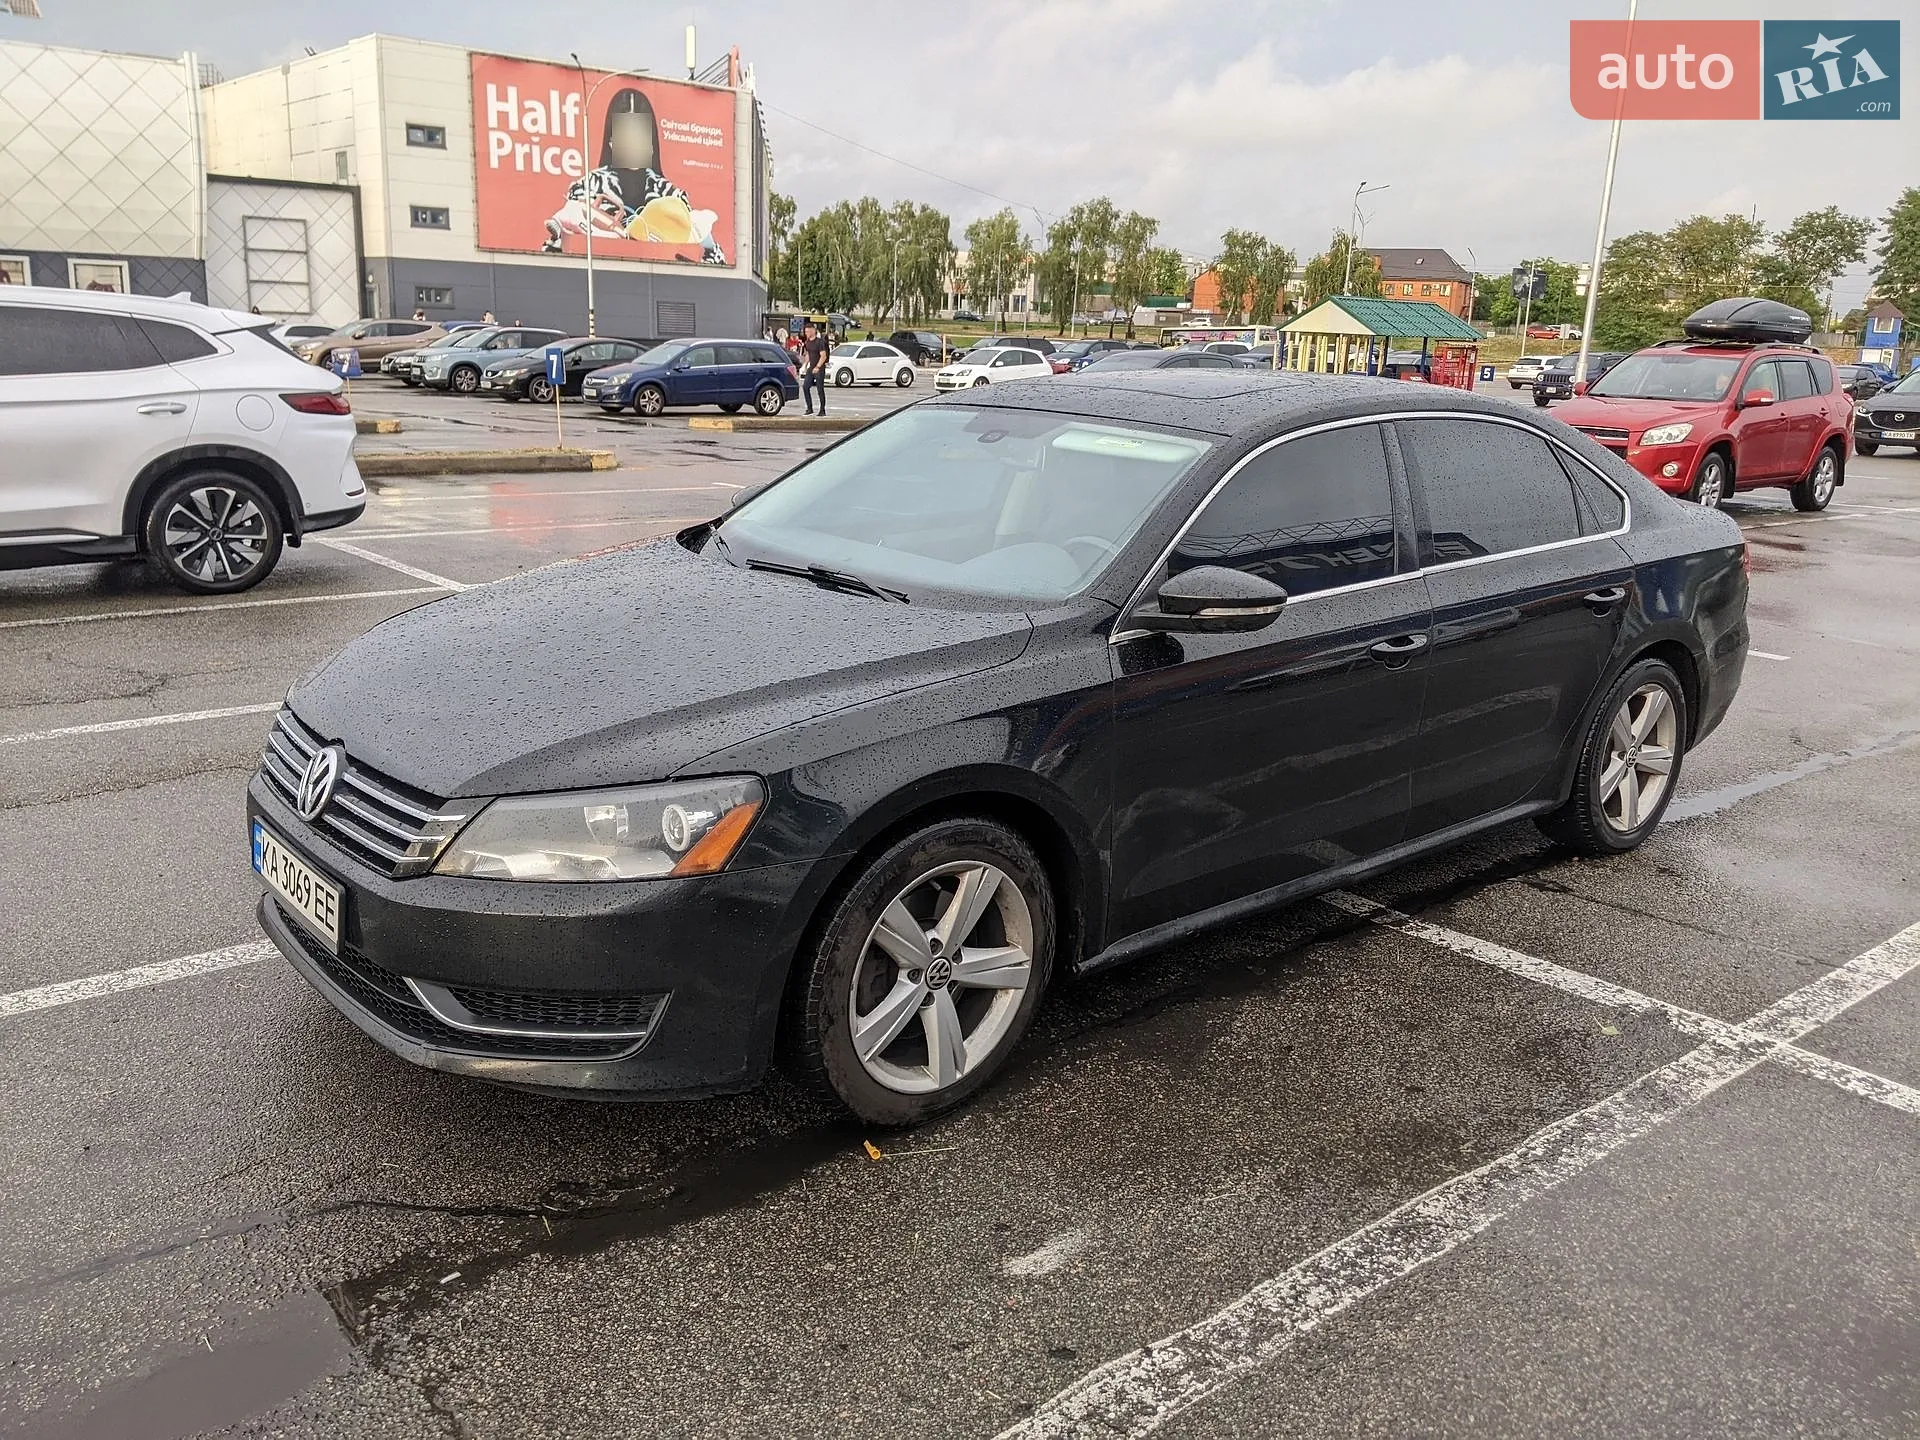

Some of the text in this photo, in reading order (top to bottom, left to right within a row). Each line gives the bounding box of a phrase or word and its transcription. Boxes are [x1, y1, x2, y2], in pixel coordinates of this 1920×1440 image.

[486, 82, 581, 138] Half
[488, 129, 583, 177] Price
[549, 354, 558, 379] 7
[1483, 367, 1491, 379] 5
[262, 836, 335, 933] KA 3069 EE
